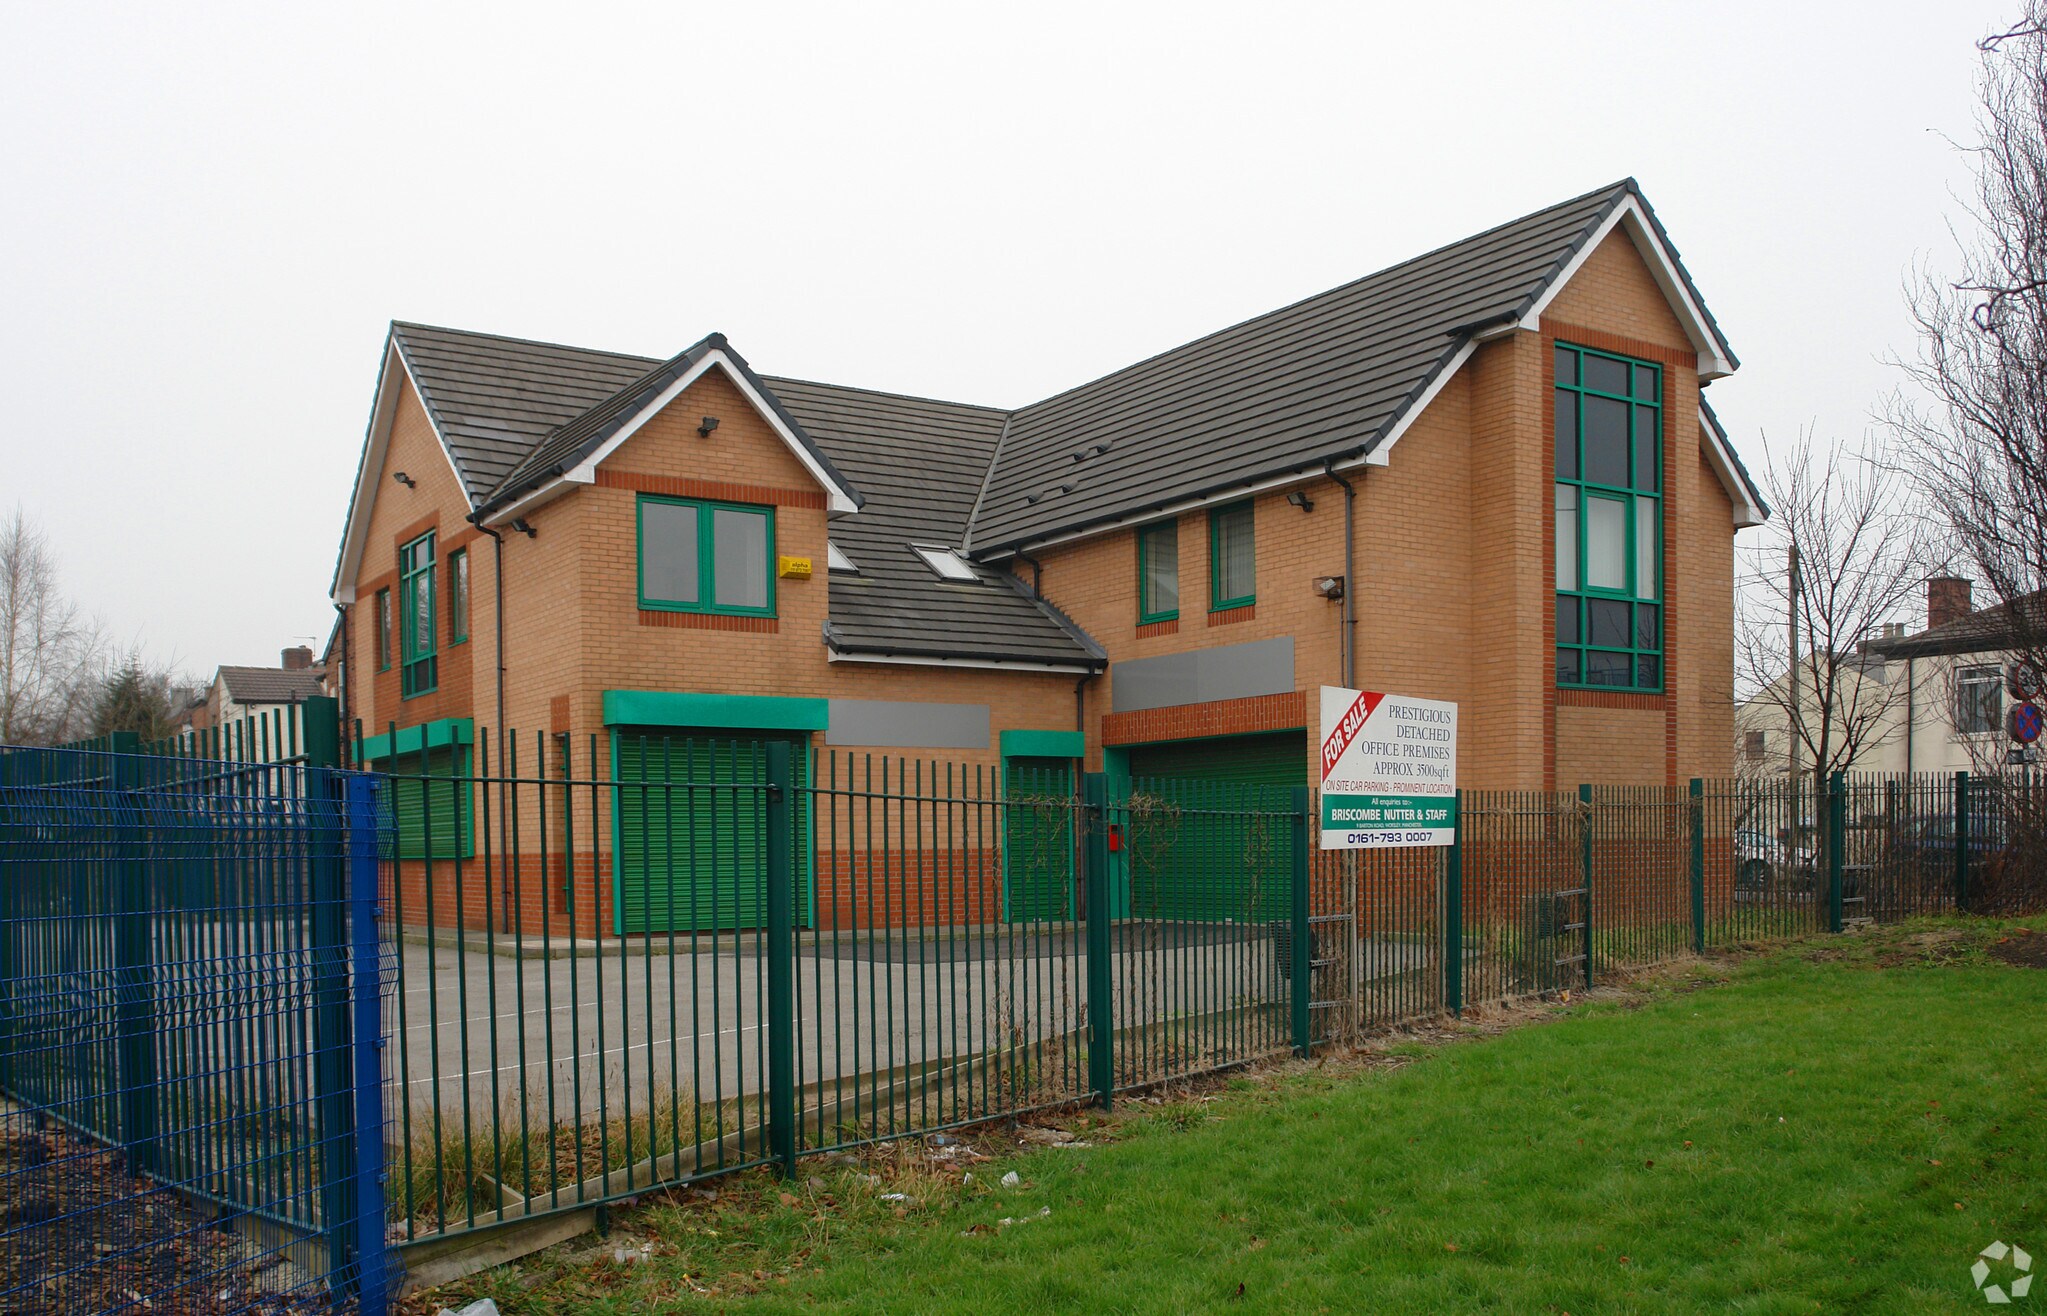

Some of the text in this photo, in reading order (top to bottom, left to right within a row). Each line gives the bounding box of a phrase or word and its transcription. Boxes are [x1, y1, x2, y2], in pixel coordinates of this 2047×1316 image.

[1389, 704, 1451, 724] PRESTIGIOUS
[1324, 695, 1368, 769] FOR SALE
[1396, 724, 1451, 742] DETACHED
[1361, 740, 1450, 760] OFFICE PREMISES
[1373, 761, 1449, 781] APPROX 3500sqft
[1325, 779, 1336, 791] ON
[1335, 780, 1350, 791] SITE
[1350, 780, 1363, 792] CAR
[1363, 781, 1389, 792] PARKING
[1392, 782, 1426, 793] PROMINENT
[1426, 783, 1453, 794] LOCATION
[1371, 797, 1379, 805] All
[1379, 798, 1401, 807] enquiries
[1331, 808, 1448, 821] BRISCOMBE NUTTER & STAFF
[1347, 831, 1433, 844] 0161-793 0007
